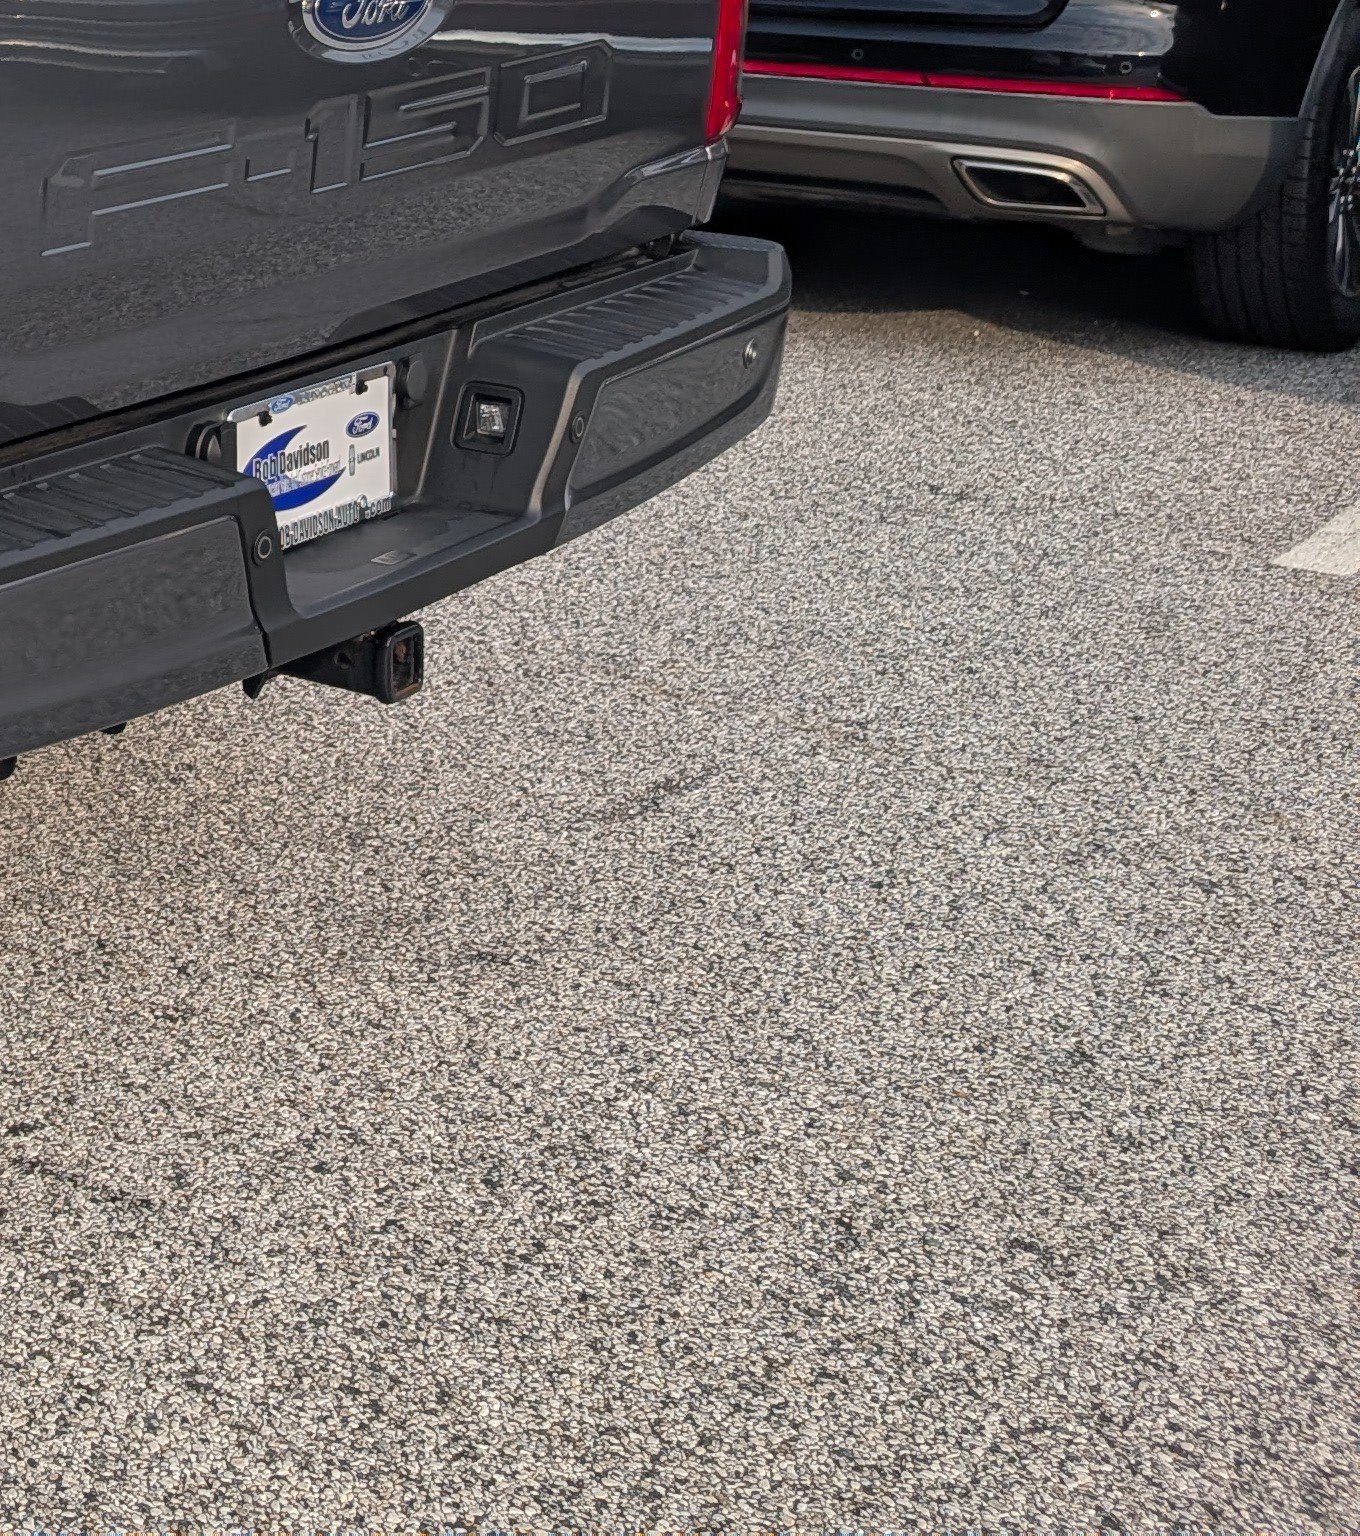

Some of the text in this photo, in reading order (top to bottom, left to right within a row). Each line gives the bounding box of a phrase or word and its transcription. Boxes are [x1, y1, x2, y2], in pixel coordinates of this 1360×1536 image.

[39, 39, 614, 256] F-150
[253, 452, 279, 481] Bob
[278, 439, 330, 474] Davidson
[357, 446, 380, 464] LINCOLN
